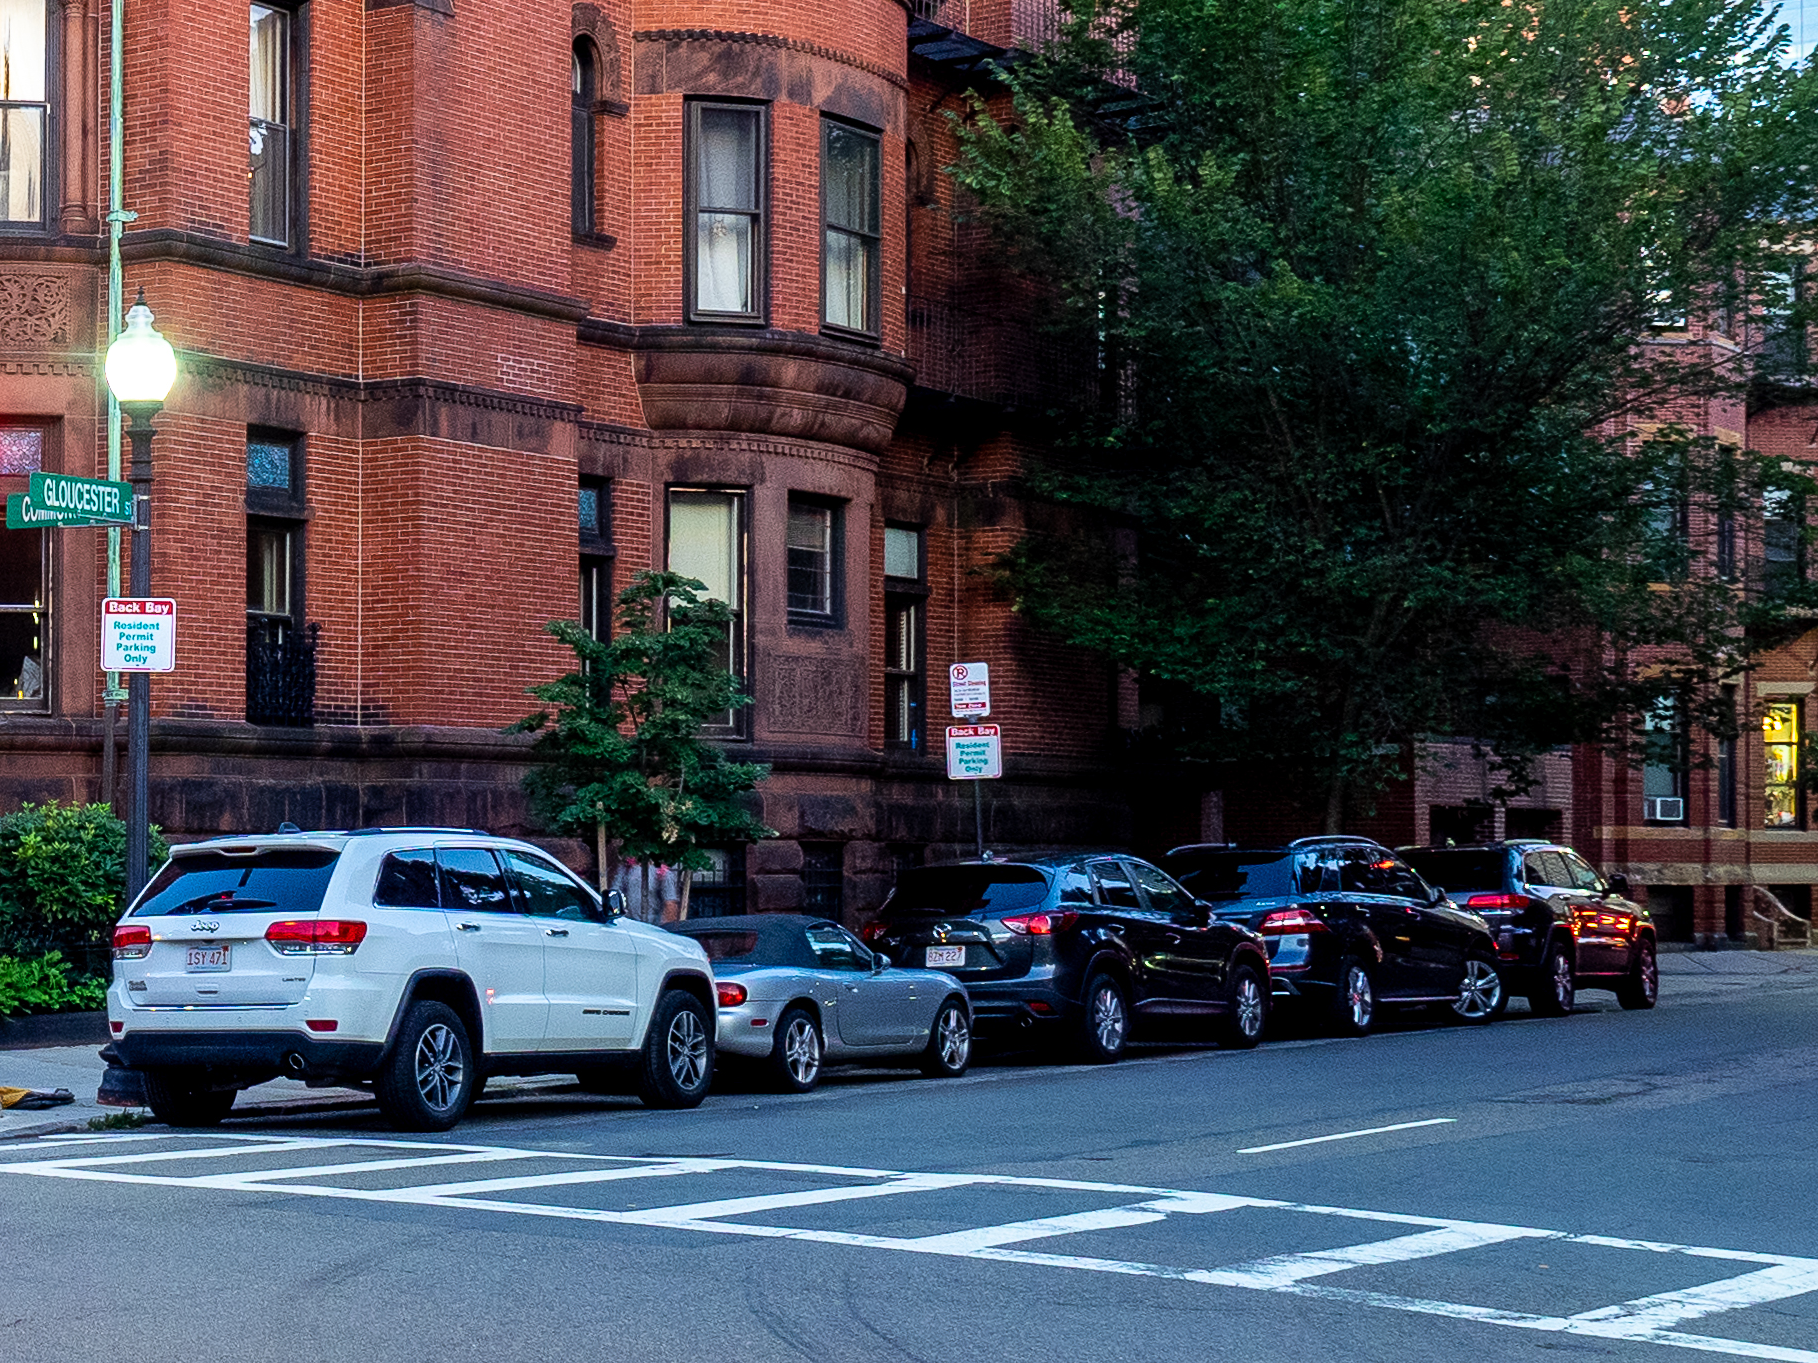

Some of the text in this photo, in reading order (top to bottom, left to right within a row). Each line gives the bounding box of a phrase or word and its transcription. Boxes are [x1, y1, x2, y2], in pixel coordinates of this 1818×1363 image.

[44, 478, 120, 513] GLOUCESTER
[109, 602, 170, 615] Back Bay
[113, 621, 160, 630] Resident
[119, 632, 154, 641] Permit
[116, 643, 157, 654] Parking
[124, 654, 148, 665] Only
[951, 727, 996, 737] Back Bay
